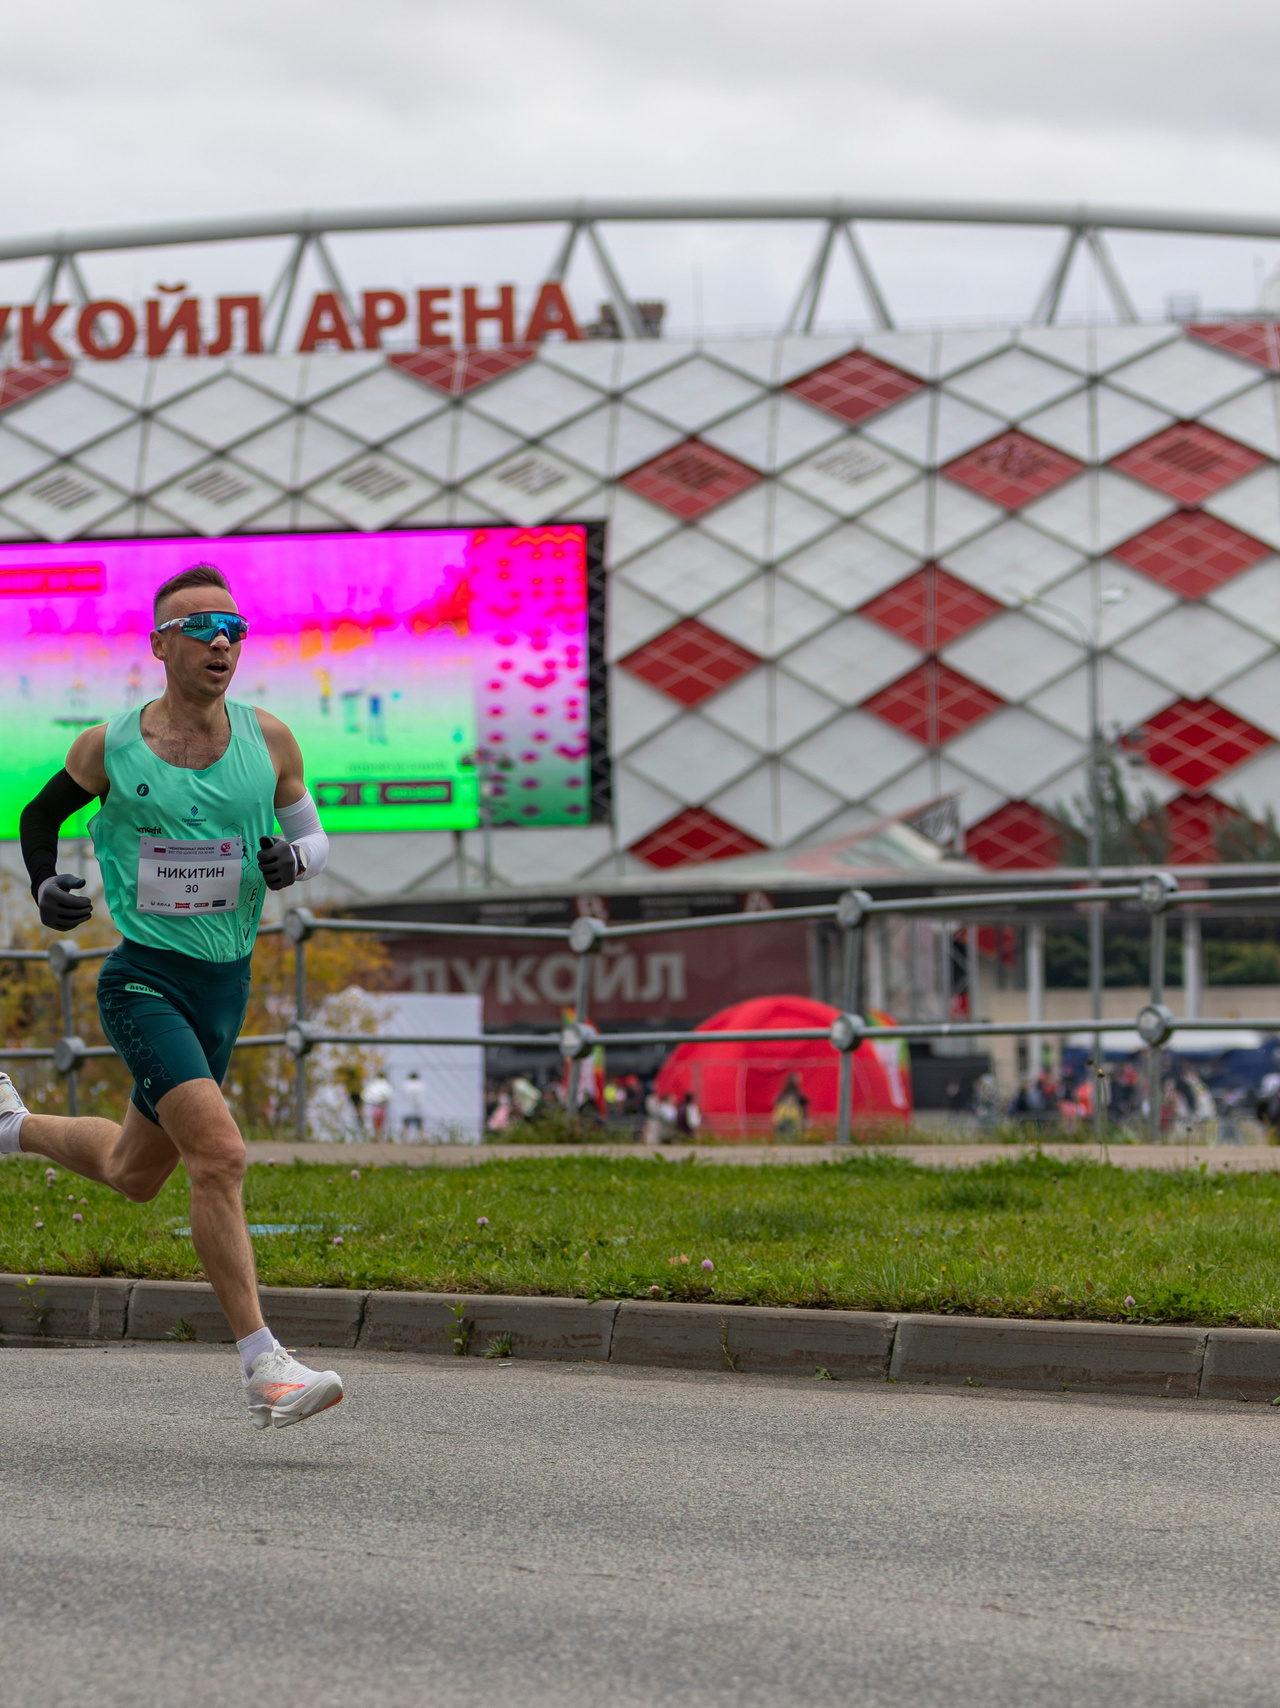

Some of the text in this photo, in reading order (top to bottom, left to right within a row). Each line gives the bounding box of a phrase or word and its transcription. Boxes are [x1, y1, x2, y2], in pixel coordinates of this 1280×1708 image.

[298, 281, 584, 353] АРЕНА
[157, 867, 225, 879] НИКИТИН
[185, 884, 199, 893] 30
